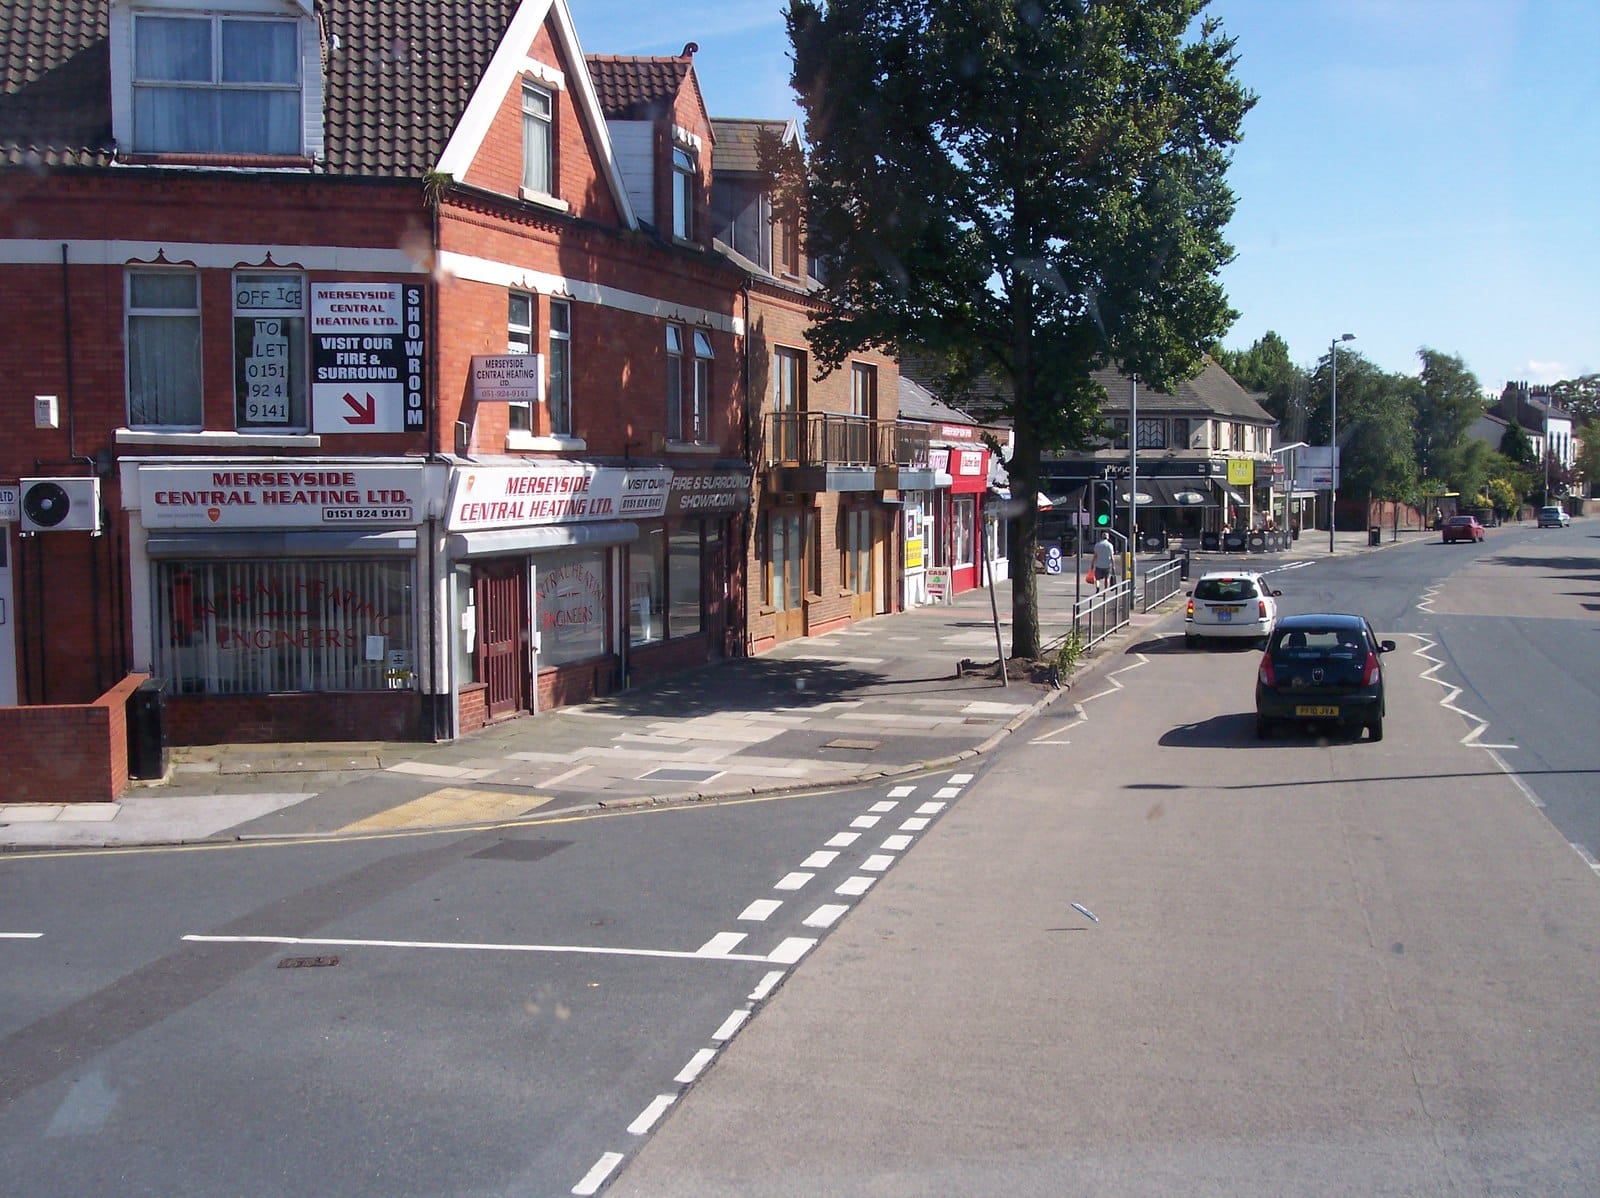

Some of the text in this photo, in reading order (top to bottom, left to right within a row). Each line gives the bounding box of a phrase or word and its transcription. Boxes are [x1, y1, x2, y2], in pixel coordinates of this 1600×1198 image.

[317, 290, 396, 300] MERSEYSIDE
[330, 304, 385, 313] CENTRAL
[255, 321, 279, 336] TO
[315, 317, 398, 326] HEATING LTD.
[255, 343, 287, 358] LET
[320, 337, 393, 350] VISIT OUR
[336, 352, 381, 365] FIRE &
[404, 289, 424, 425] SHOWROOM
[485, 359, 524, 368] MERSEYSIDE
[248, 363, 286, 378] 0151
[317, 367, 398, 379] SURROUND
[476, 369, 534, 379] CENTRAL HEATING
[251, 384, 283, 397] 924
[249, 403, 286, 418] 9141
[212, 472, 355, 487] MERSEYSIDE
[505, 475, 591, 495] MERSEYSIDE
[627, 478, 648, 490] VISIT
[670, 475, 751, 490] FIRE & SURROUND
[154, 490, 412, 506] CENTRAL HEATING LTD.
[679, 493, 736, 509] SHOWROOM
[326, 509, 407, 519] 0151 924 9141
[460, 498, 613, 522] CENTRAL HEATING LTD.
[217, 628, 359, 651] ENGINEERS
